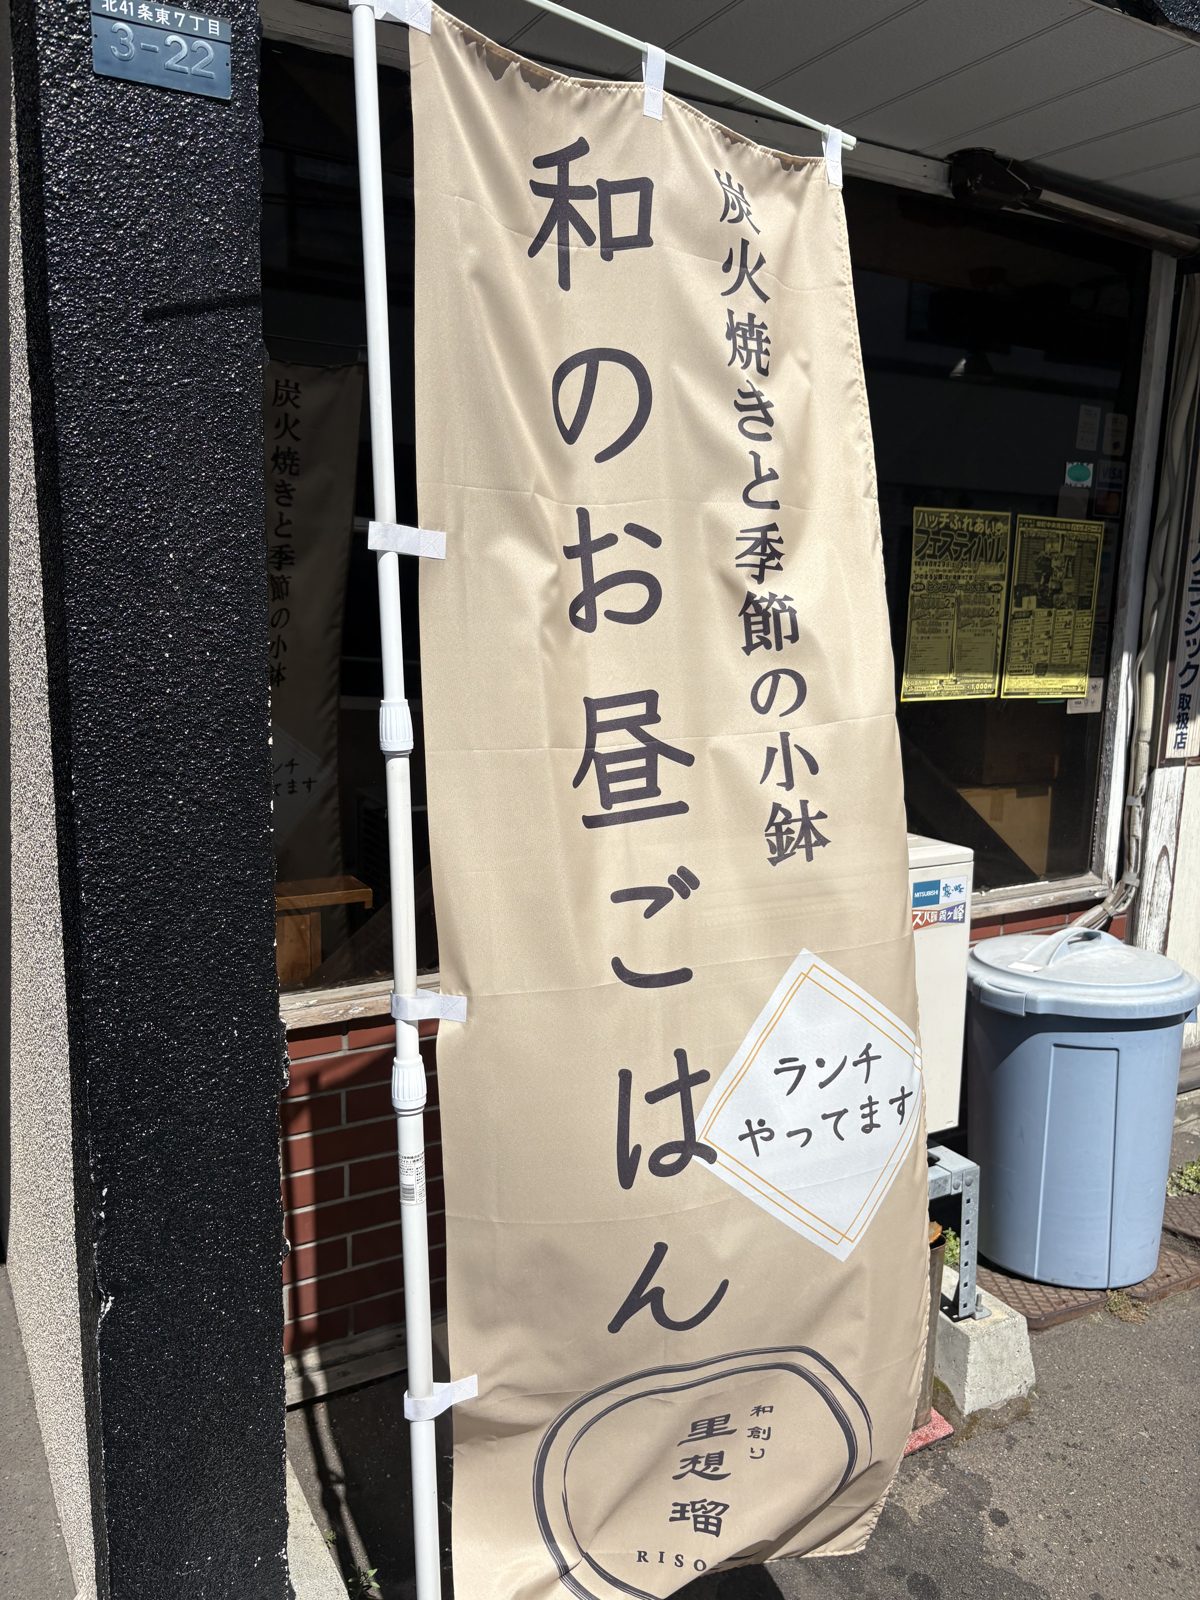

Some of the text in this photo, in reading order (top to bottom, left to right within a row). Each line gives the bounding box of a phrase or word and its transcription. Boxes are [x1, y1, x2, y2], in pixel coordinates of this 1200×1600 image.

[101, 0, 220, 36] 北41条東7丁目
[111, 22, 215, 80] 3-22
[714, 168, 831, 867] 炭火焼きと季節の小鉢
[914, 528, 1007, 562] フェスティバル
[527, 136, 730, 1334] 和のお昼ごはん
[774, 1043, 882, 1096] ランチ
[738, 1086, 914, 1157] やってます
[747, 1404, 774, 1460] 和創り
[669, 1413, 737, 1538] 里想瑠
[637, 1550, 707, 1571] RISO
